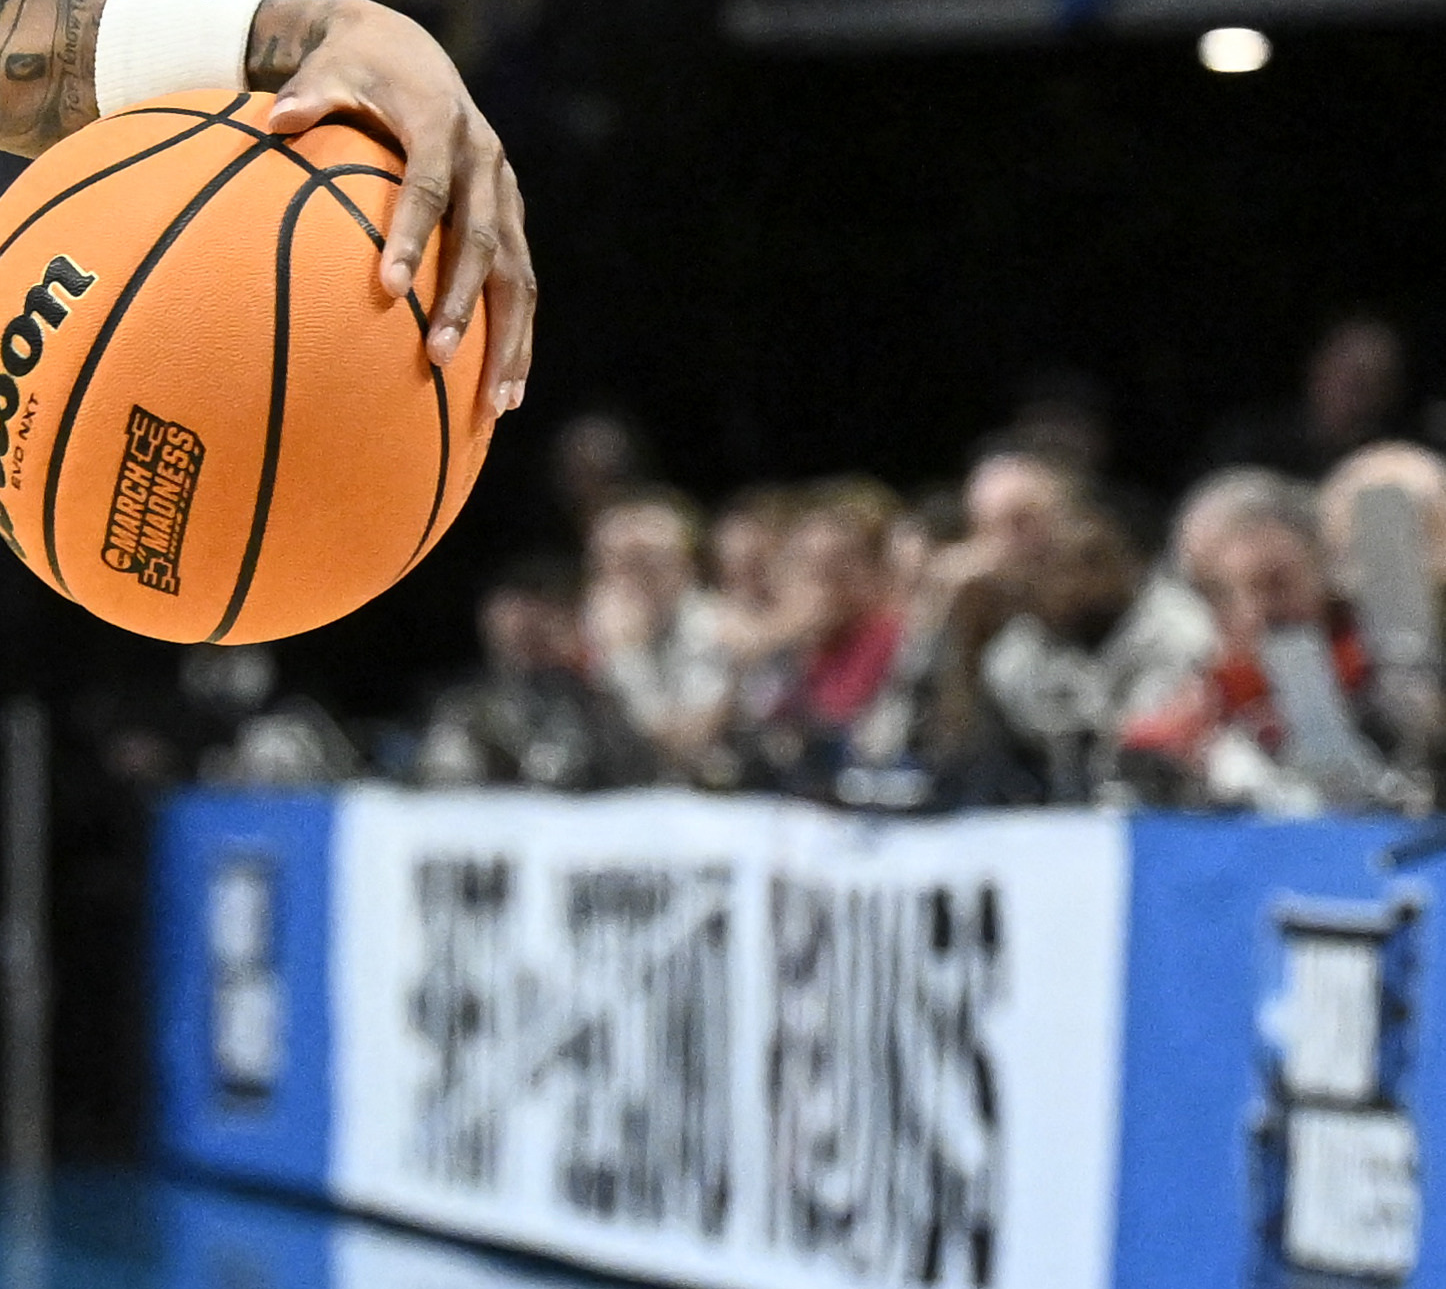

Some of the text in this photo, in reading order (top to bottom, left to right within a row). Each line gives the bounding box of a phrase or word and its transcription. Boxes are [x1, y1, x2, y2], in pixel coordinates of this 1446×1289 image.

[20, 392, 40, 442] NXT
[109, 460, 154, 555] MARCH
[139, 425, 195, 554] MADNESS
